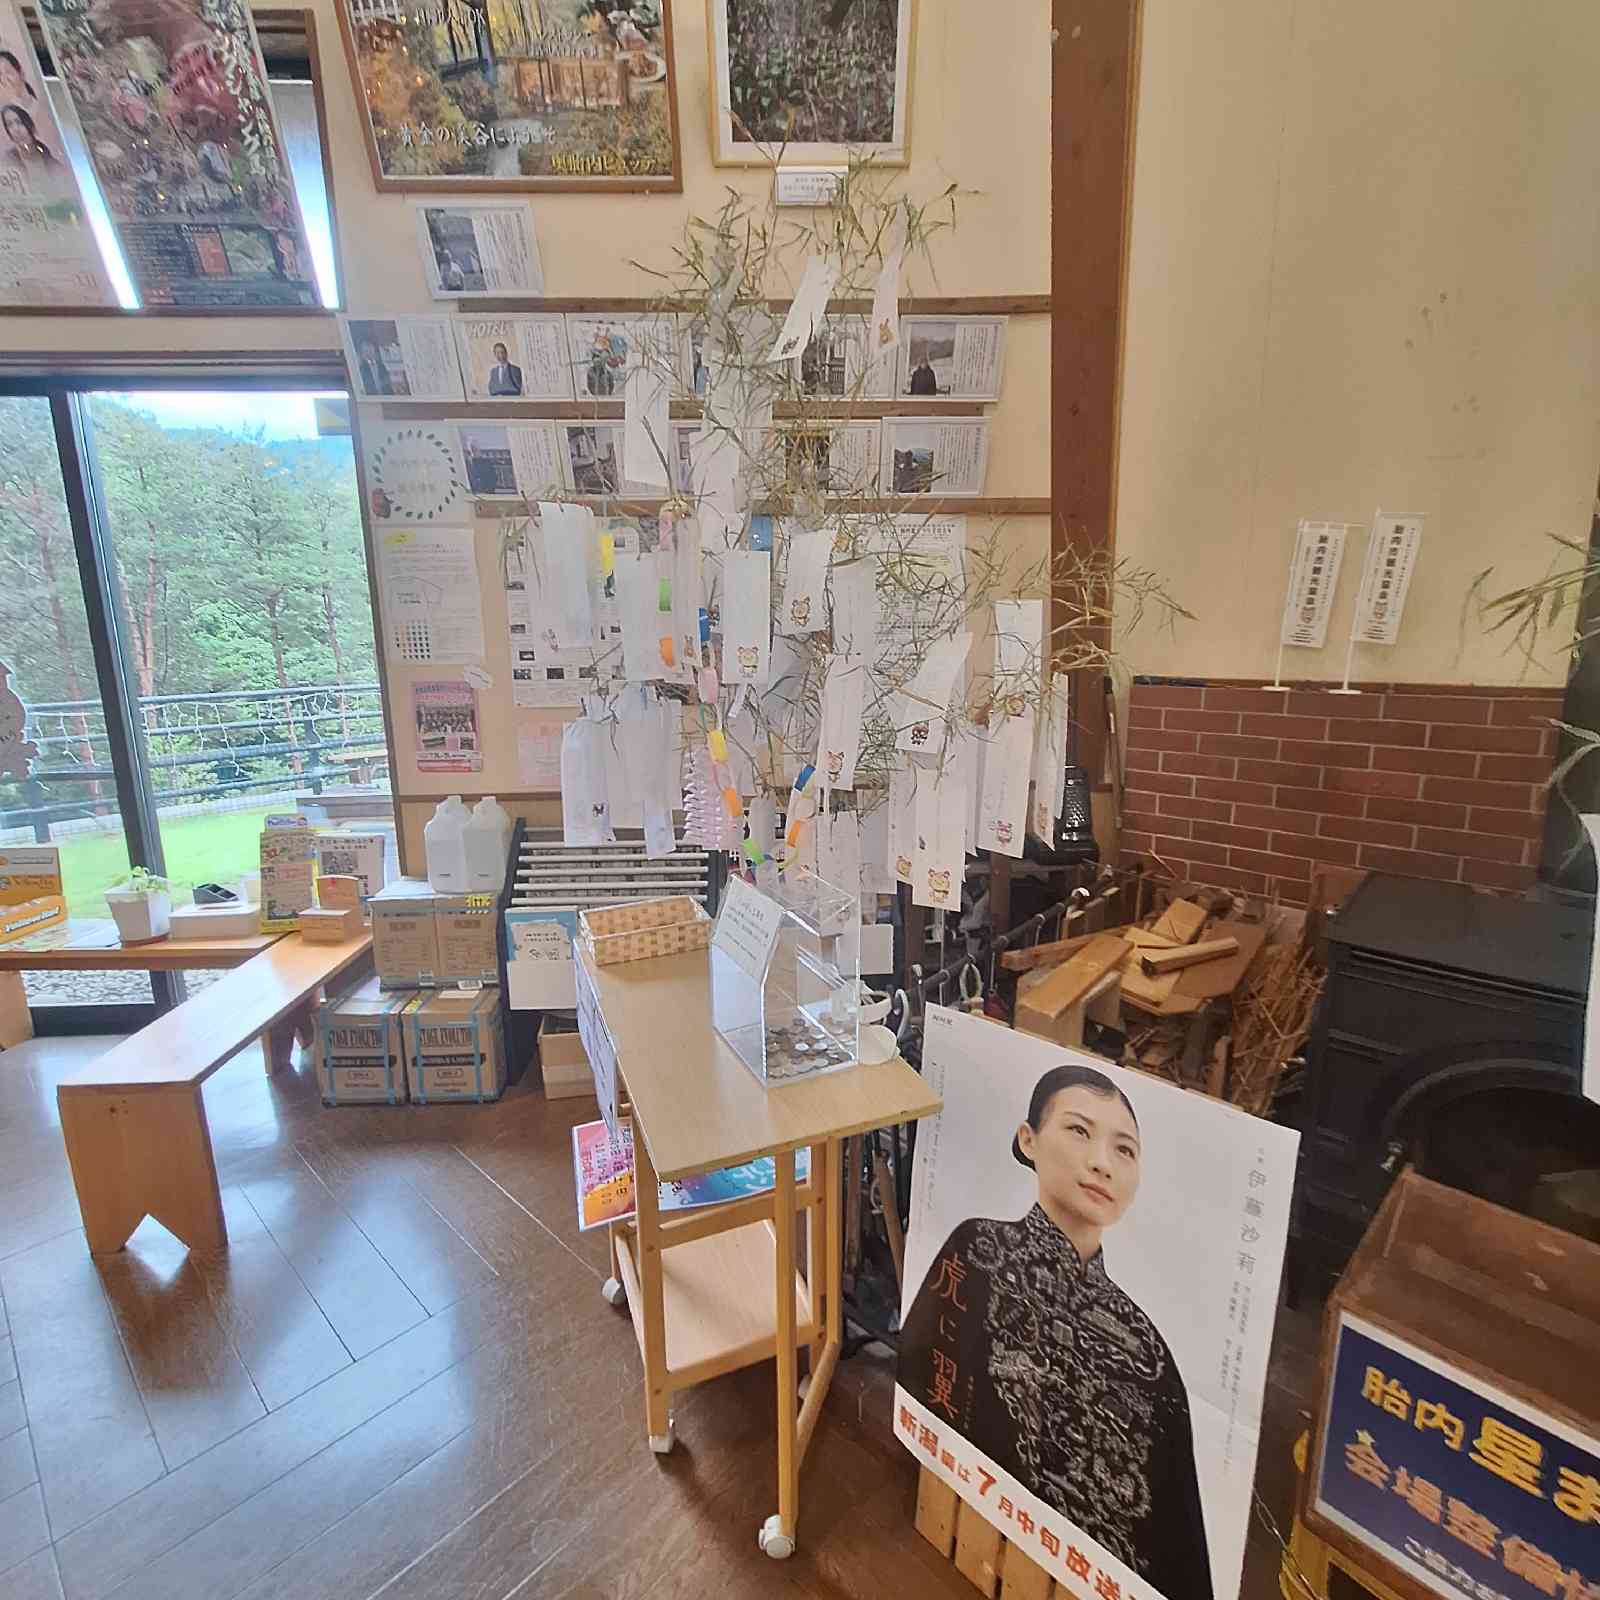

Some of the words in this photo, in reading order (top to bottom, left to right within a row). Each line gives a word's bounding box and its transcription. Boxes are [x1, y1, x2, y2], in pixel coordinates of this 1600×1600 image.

[932, 1014, 953, 1025] NHK
[1238, 1169, 1267, 1275] 伊藤沙莉
[926, 1252, 968, 1420] 虎に翼
[1344, 1442, 1600, 1600] 会場整備
